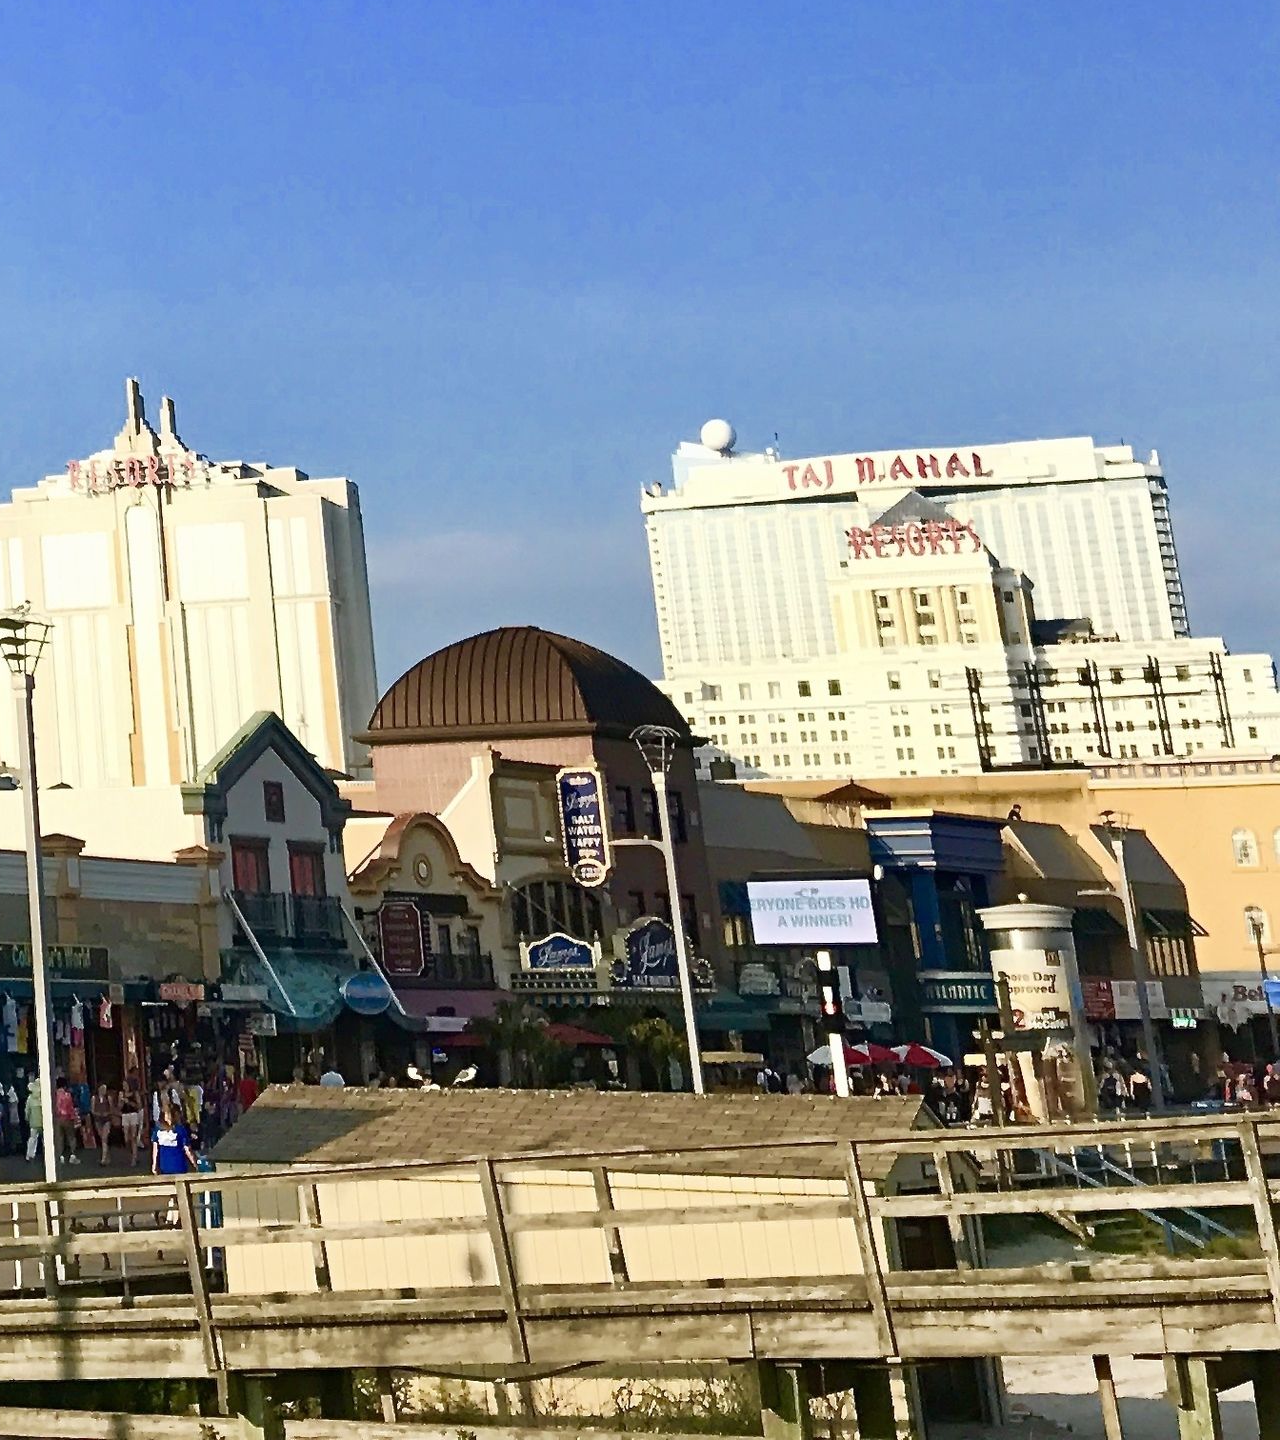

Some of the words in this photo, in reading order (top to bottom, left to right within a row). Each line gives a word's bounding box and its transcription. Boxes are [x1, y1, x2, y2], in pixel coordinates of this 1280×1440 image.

[782, 460, 834, 491] TAJ
[848, 519, 982, 559] RESORTS
[778, 915, 789, 928] A
